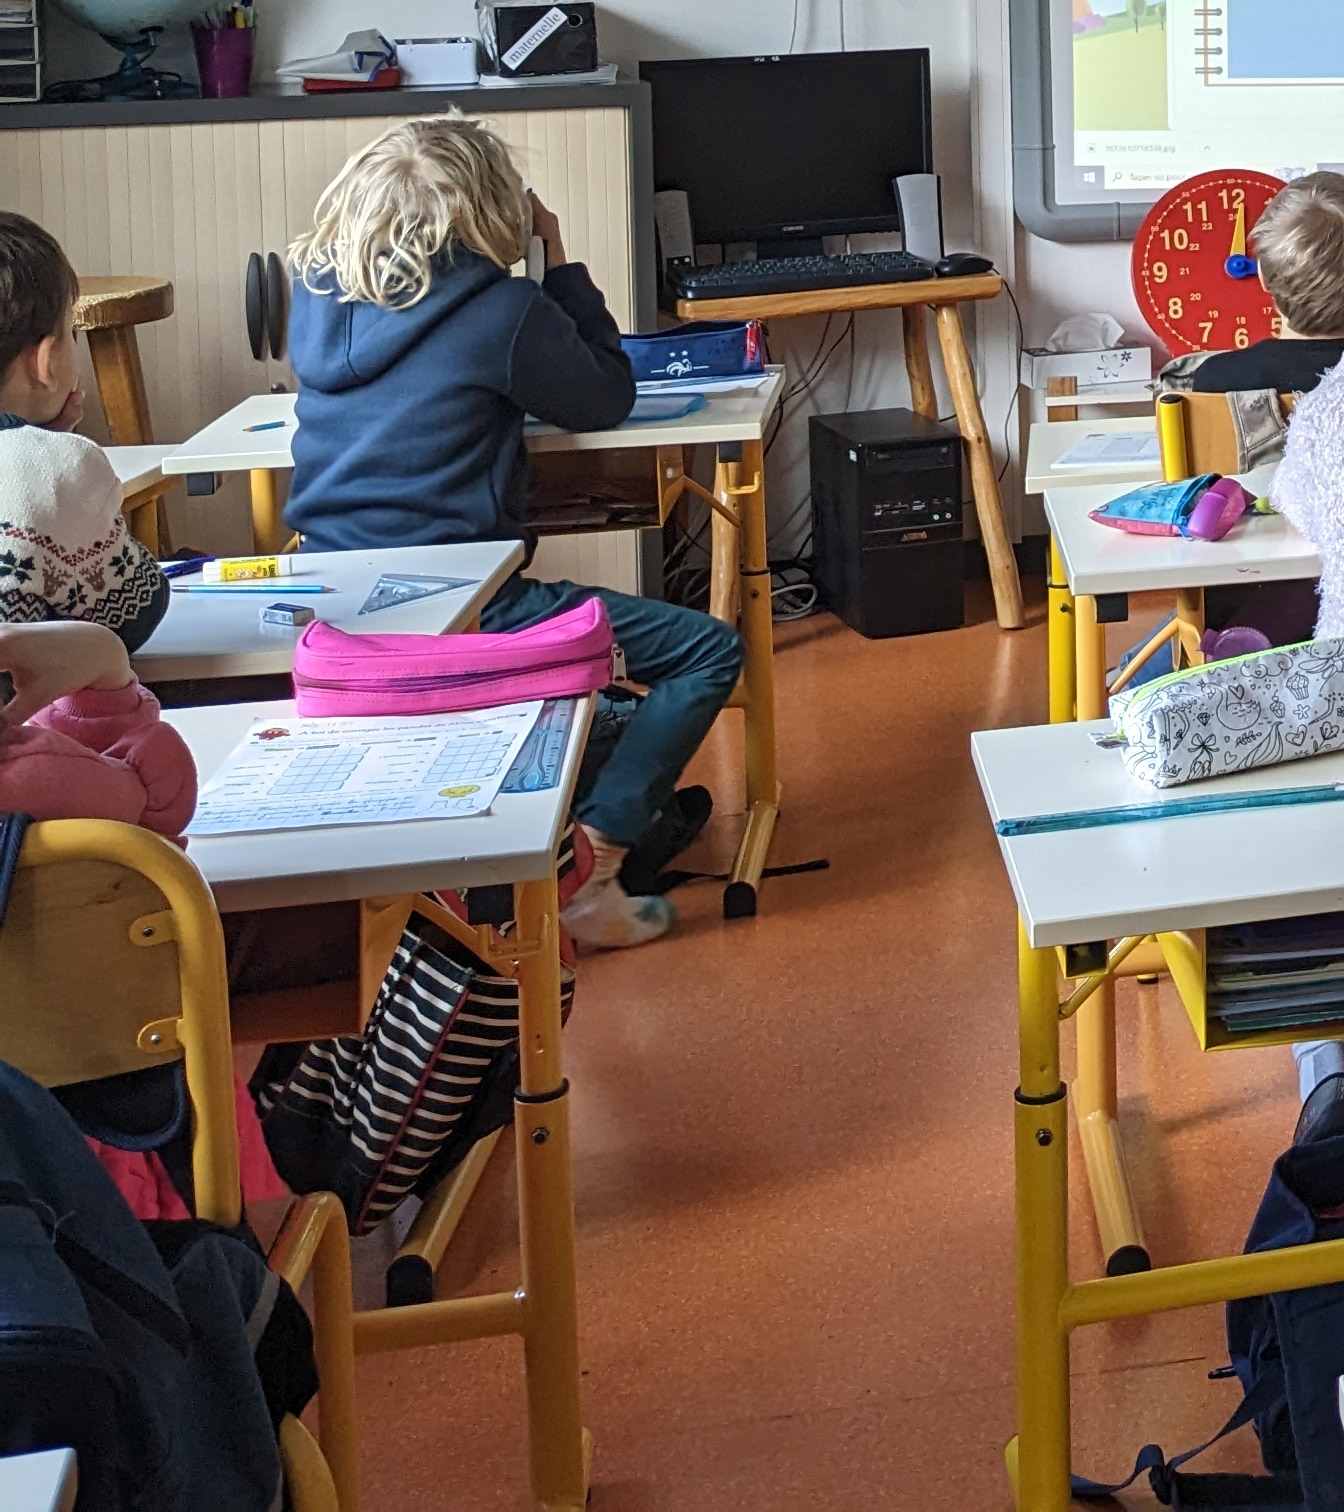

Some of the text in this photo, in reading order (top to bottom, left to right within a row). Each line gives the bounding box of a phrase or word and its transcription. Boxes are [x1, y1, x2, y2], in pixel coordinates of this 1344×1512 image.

[509, 12, 561, 63] maternelle
[1182, 201, 1209, 222] 11
[1160, 228, 1189, 250] 10
[1153, 261, 1168, 284] 9
[1168, 297, 1183, 319] 8
[1198, 321, 1213, 343] 7
[1234, 328, 1249, 349] 6
